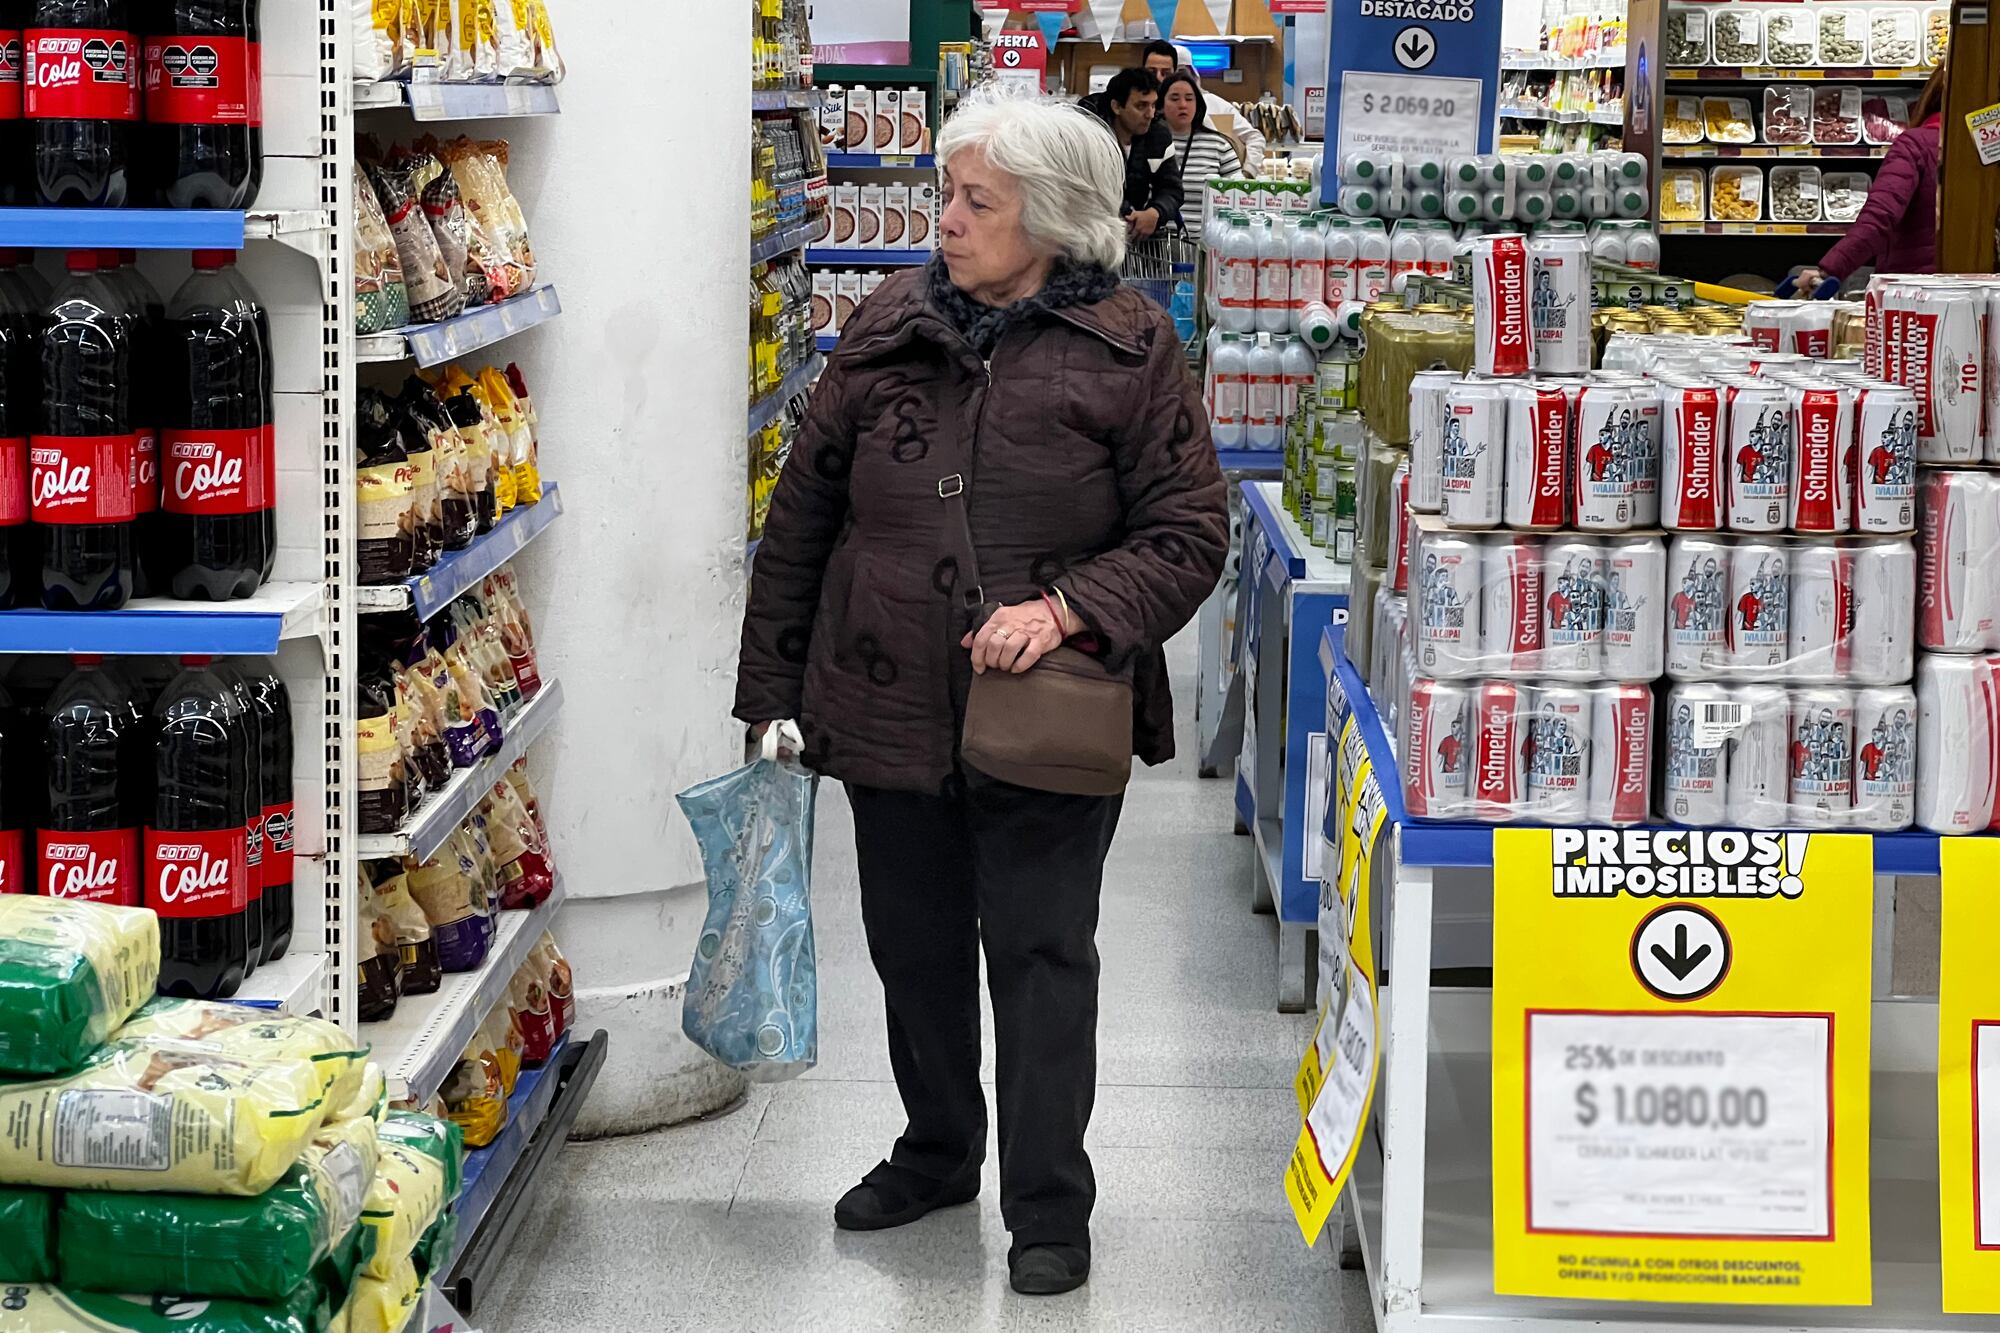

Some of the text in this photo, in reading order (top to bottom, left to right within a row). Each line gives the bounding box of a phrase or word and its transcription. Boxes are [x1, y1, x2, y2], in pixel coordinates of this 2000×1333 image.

[1360, 0, 1474, 22] DESTACADO
[37, 38, 82, 53] COTO
[996, 35, 1039, 48] FERTA
[38, 56, 81, 88] Cola
[823, 102, 843, 114] Silk
[1500, 260, 1521, 345] Schneider
[1542, 330, 1562, 338] COPA!
[1962, 364, 1977, 394] 710
[31, 449, 62, 465] COTO
[172, 442, 216, 459] COTO
[1541, 410, 1563, 497] Schneider
[1687, 412, 1711, 499] Schneider
[1804, 413, 1830, 501] Schneider
[32, 457, 91, 507] Cola
[175, 450, 243, 500] Cola
[1451, 479, 1471, 488] COPA!
[1921, 504, 1939, 609] Schneider
[1520, 560, 1539, 645] Schneider
[1429, 629, 1438, 639] LA
[1611, 631, 1631, 642] COPA!
[1407, 700, 1424, 787] Schneider
[1482, 705, 1507, 791] Schneider
[1623, 707, 1646, 794] Schneider
[1545, 775, 1554, 785] LA
[1556, 776, 1577, 786] COPA!
[1681, 779, 1691, 788] LA
[1692, 779, 1713, 789] COPA!
[1824, 782, 1832, 791] LA
[46, 844, 89, 860] COTO
[157, 845, 202, 860] COTO
[49, 852, 117, 898] Cola
[160, 852, 229, 903] Cola
[1564, 1044, 1617, 1071] 25%
[1641, 1050, 1725, 1068] DESCUENTO
[1574, 1081, 1768, 1131] $ 1.080,00
[1558, 1254, 1576, 1265] NO
[1581, 1256, 1641, 1268] ACUMULA
[1645, 1258, 1674, 1269] CON
[1679, 1259, 1719, 1270] OTROS
[1558, 1269, 1607, 1281] OFERTAS
[1638, 1271, 1728, 1285] PROMOCIONES
[1732, 1274, 1801, 1286] BANCARIAS
